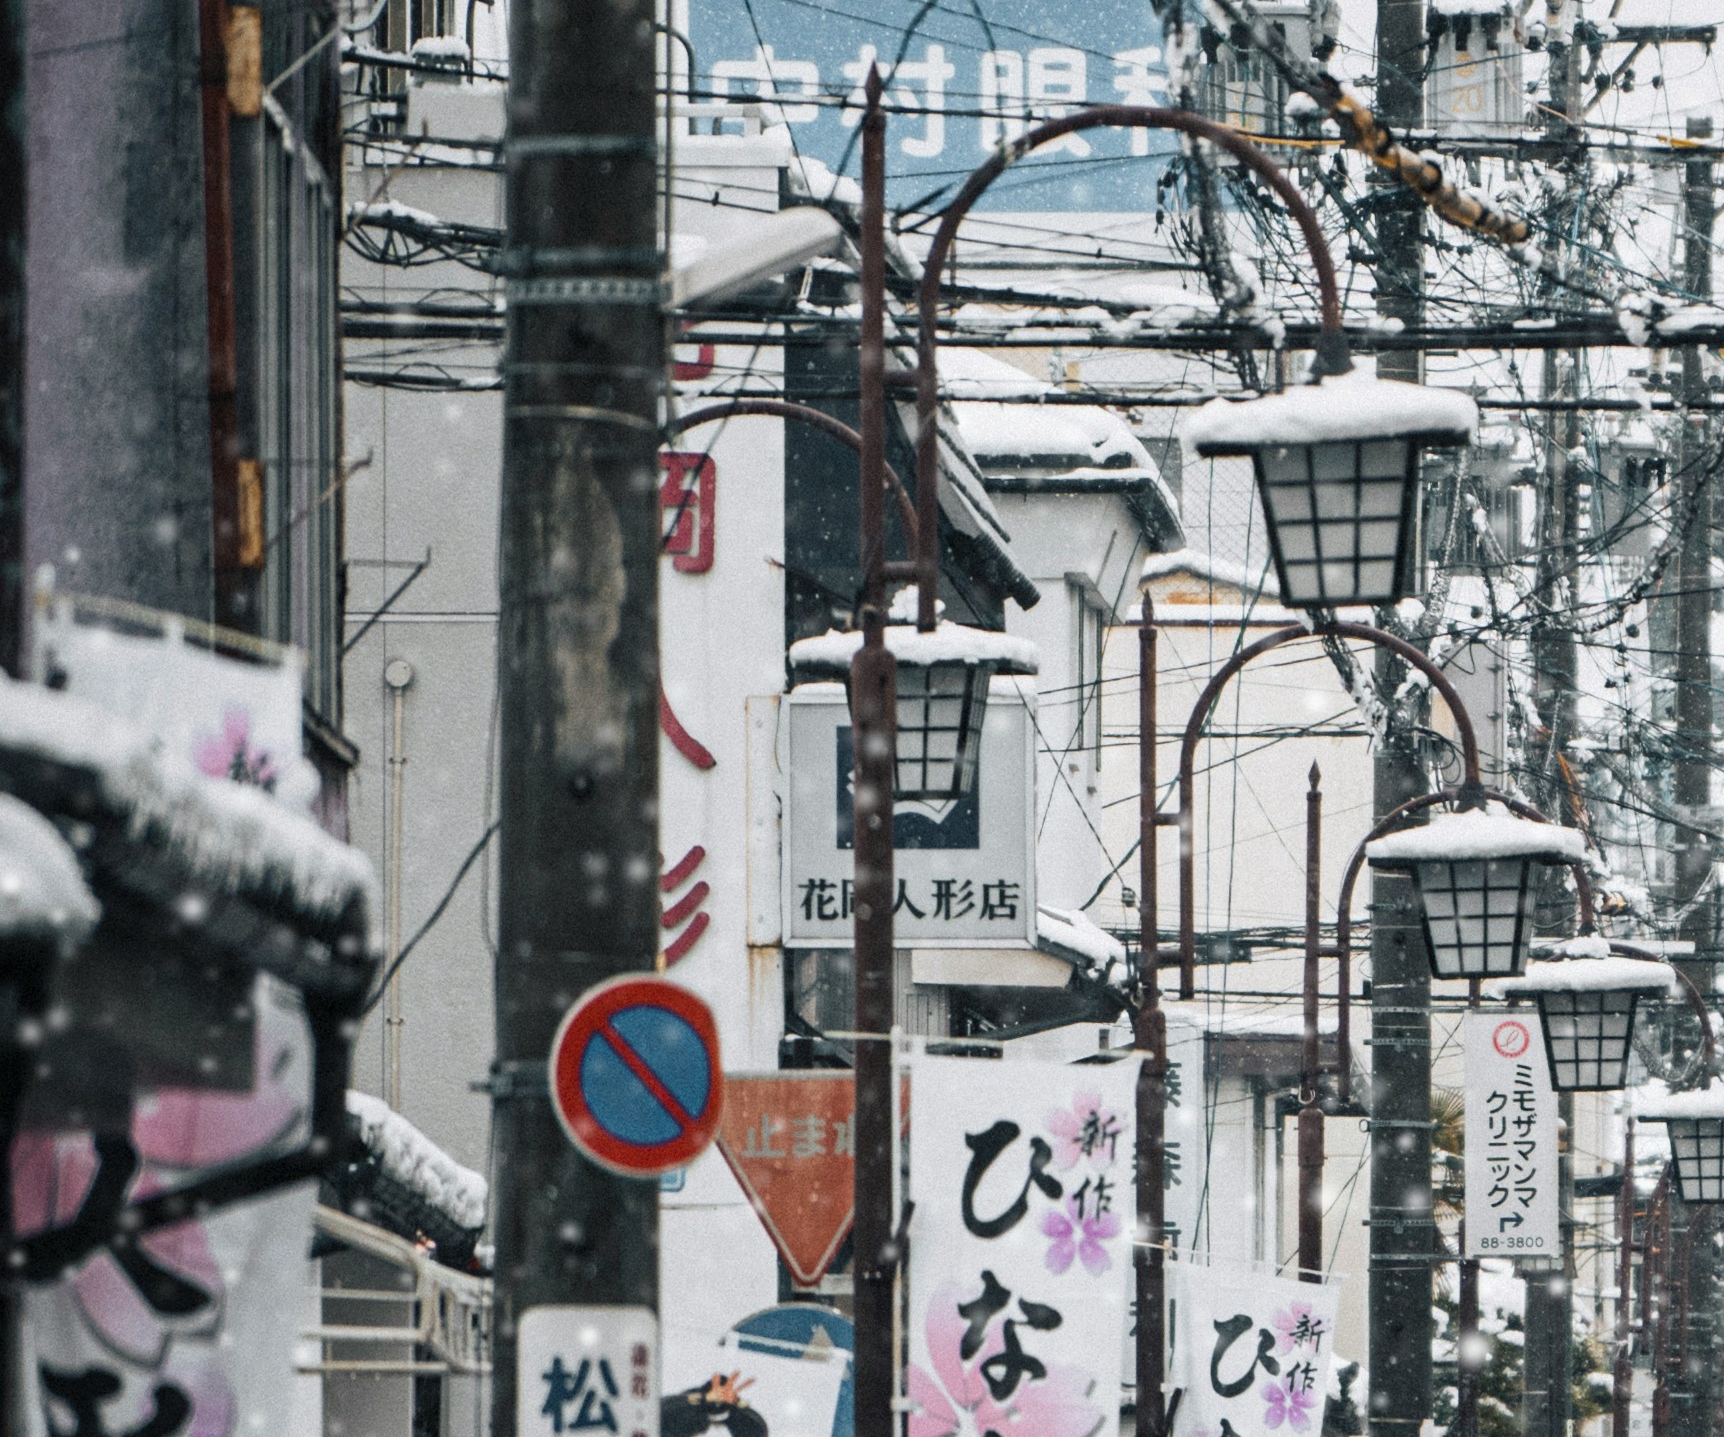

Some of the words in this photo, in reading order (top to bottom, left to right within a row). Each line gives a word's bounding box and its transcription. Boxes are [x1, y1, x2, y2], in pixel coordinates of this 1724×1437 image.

[1070, 1109, 1121, 1223] 新作
[1486, 1091, 1510, 1208] クリニック
[1512, 1064, 1538, 1208] ミモザマンマ
[1481, 1236, 1544, 1249] 88-3800
[1284, 1313, 1326, 1395] 新作
